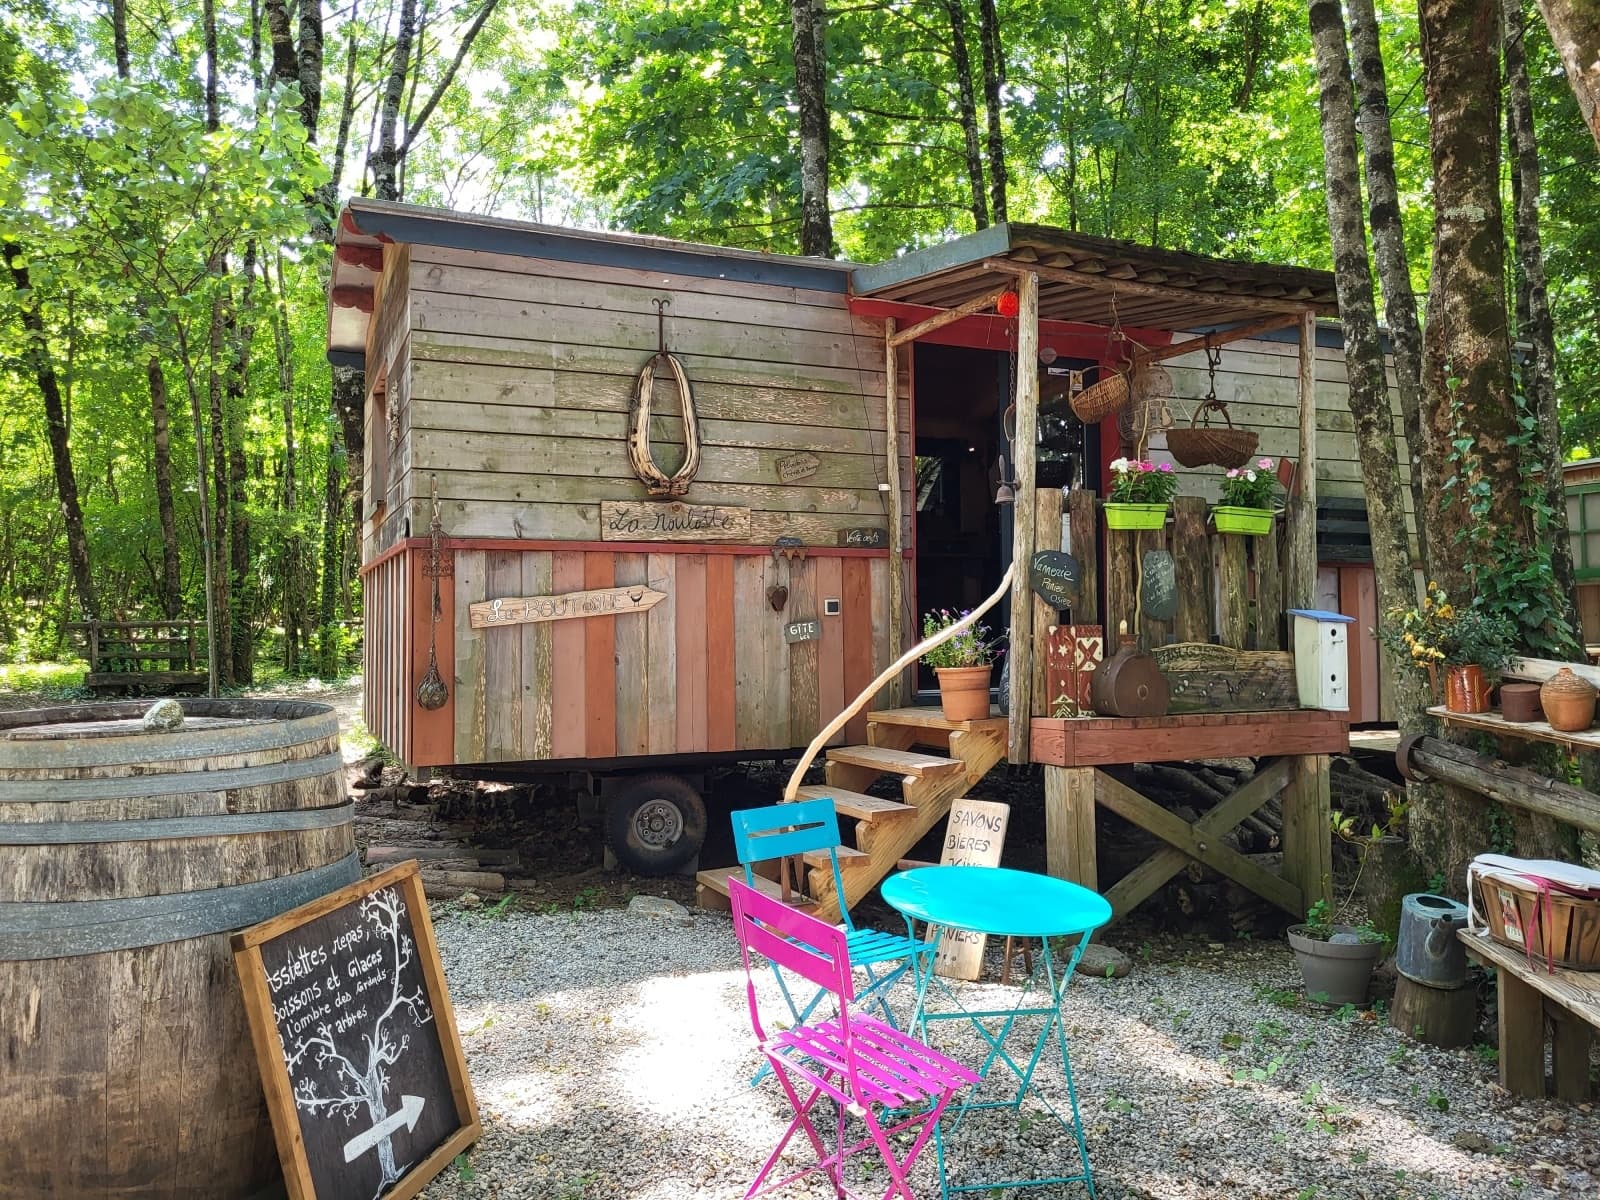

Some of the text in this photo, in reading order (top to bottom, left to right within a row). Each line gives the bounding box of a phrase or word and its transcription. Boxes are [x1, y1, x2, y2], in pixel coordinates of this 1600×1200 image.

[609, 508, 641, 533] La
[953, 810, 1002, 832] SAVONS
[327, 964, 341, 990] et
[347, 948, 383, 978] Glaces
[286, 967, 388, 1039] l'ombre des Grands
[336, 1004, 368, 1034] arbres
